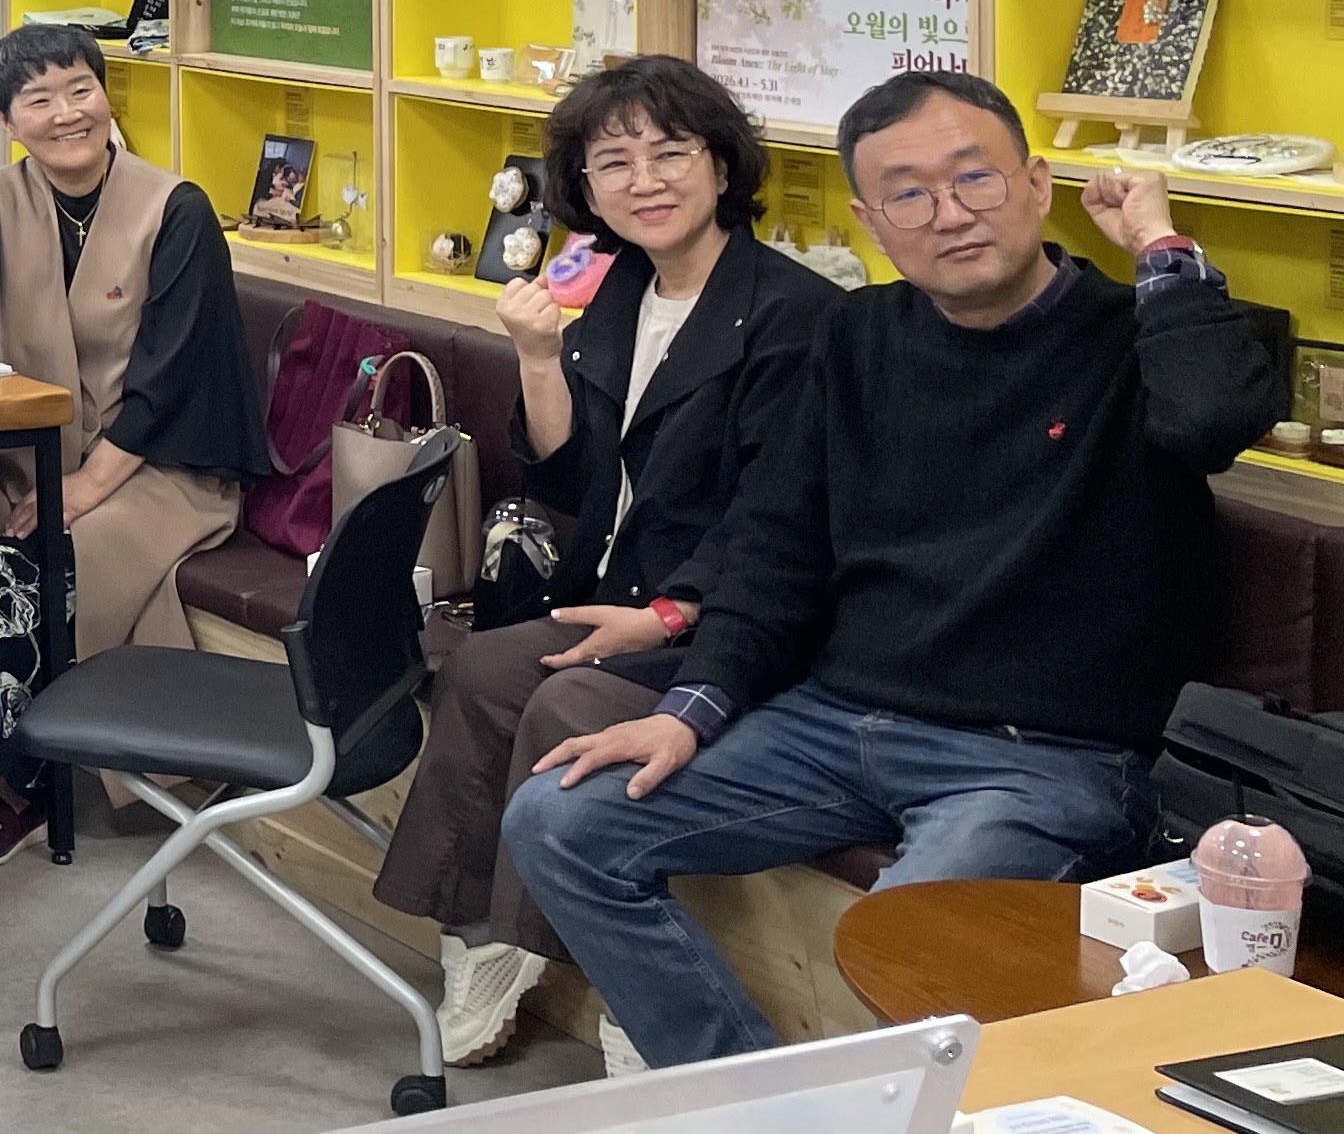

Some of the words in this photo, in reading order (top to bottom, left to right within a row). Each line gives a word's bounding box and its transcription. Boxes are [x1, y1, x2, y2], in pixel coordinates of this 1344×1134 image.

[843, 10, 907, 43] 오월의
[918, 14, 968, 44] 빛으
[1241, 931, 1269, 943] Cafe
